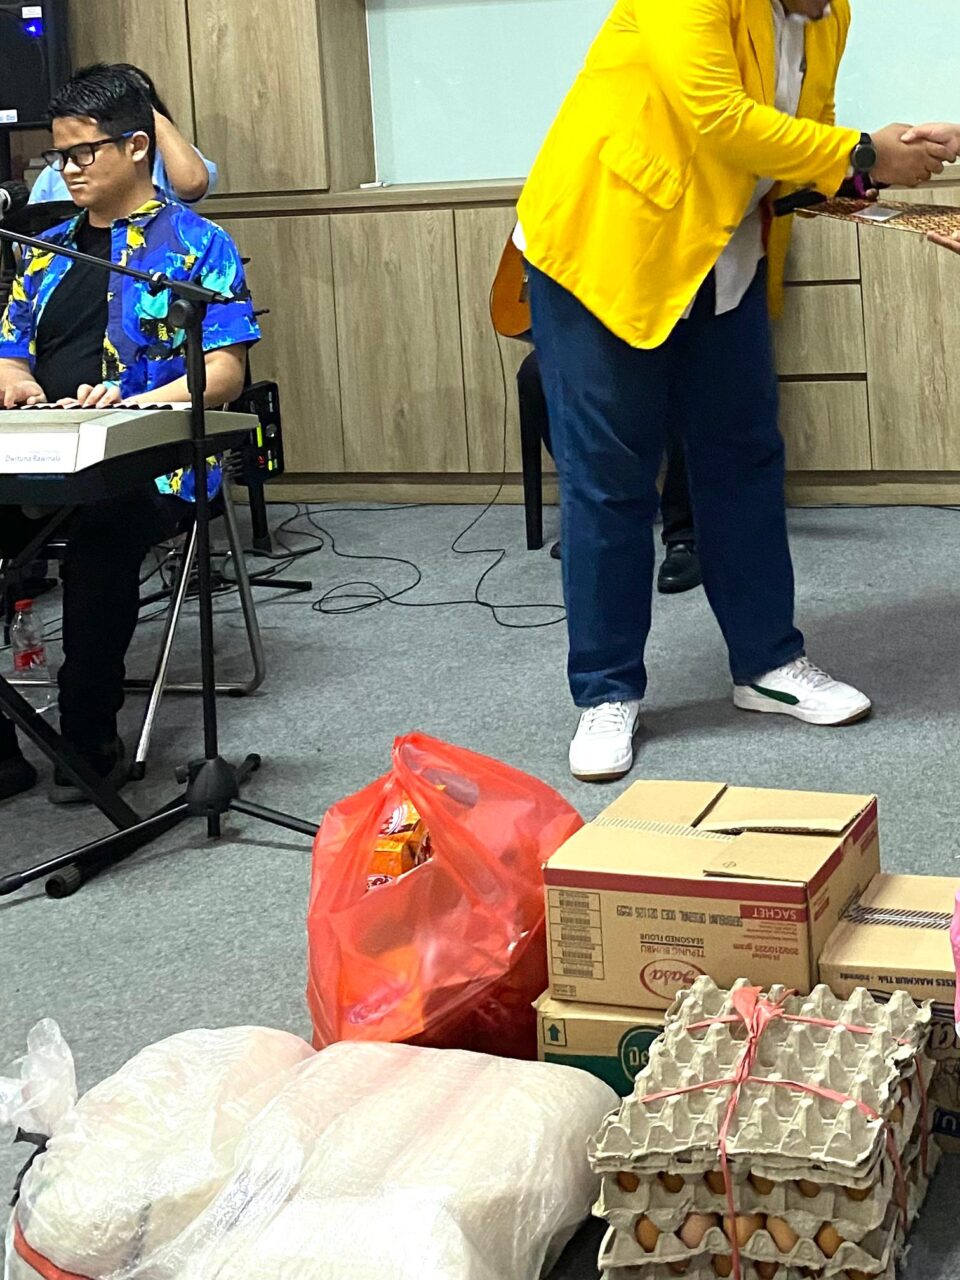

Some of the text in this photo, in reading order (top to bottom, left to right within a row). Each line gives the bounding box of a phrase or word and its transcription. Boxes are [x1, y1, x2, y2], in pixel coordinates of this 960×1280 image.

[751, 906, 797, 920] SACHET
[665, 934, 704, 945] SEASONED
[640, 945, 705, 958] TEPUNG BUMBU
[878, 975, 894, 984] Tbk
[895, 976, 934, 986] MAKMUR
[630, 1047, 649, 1066] De
